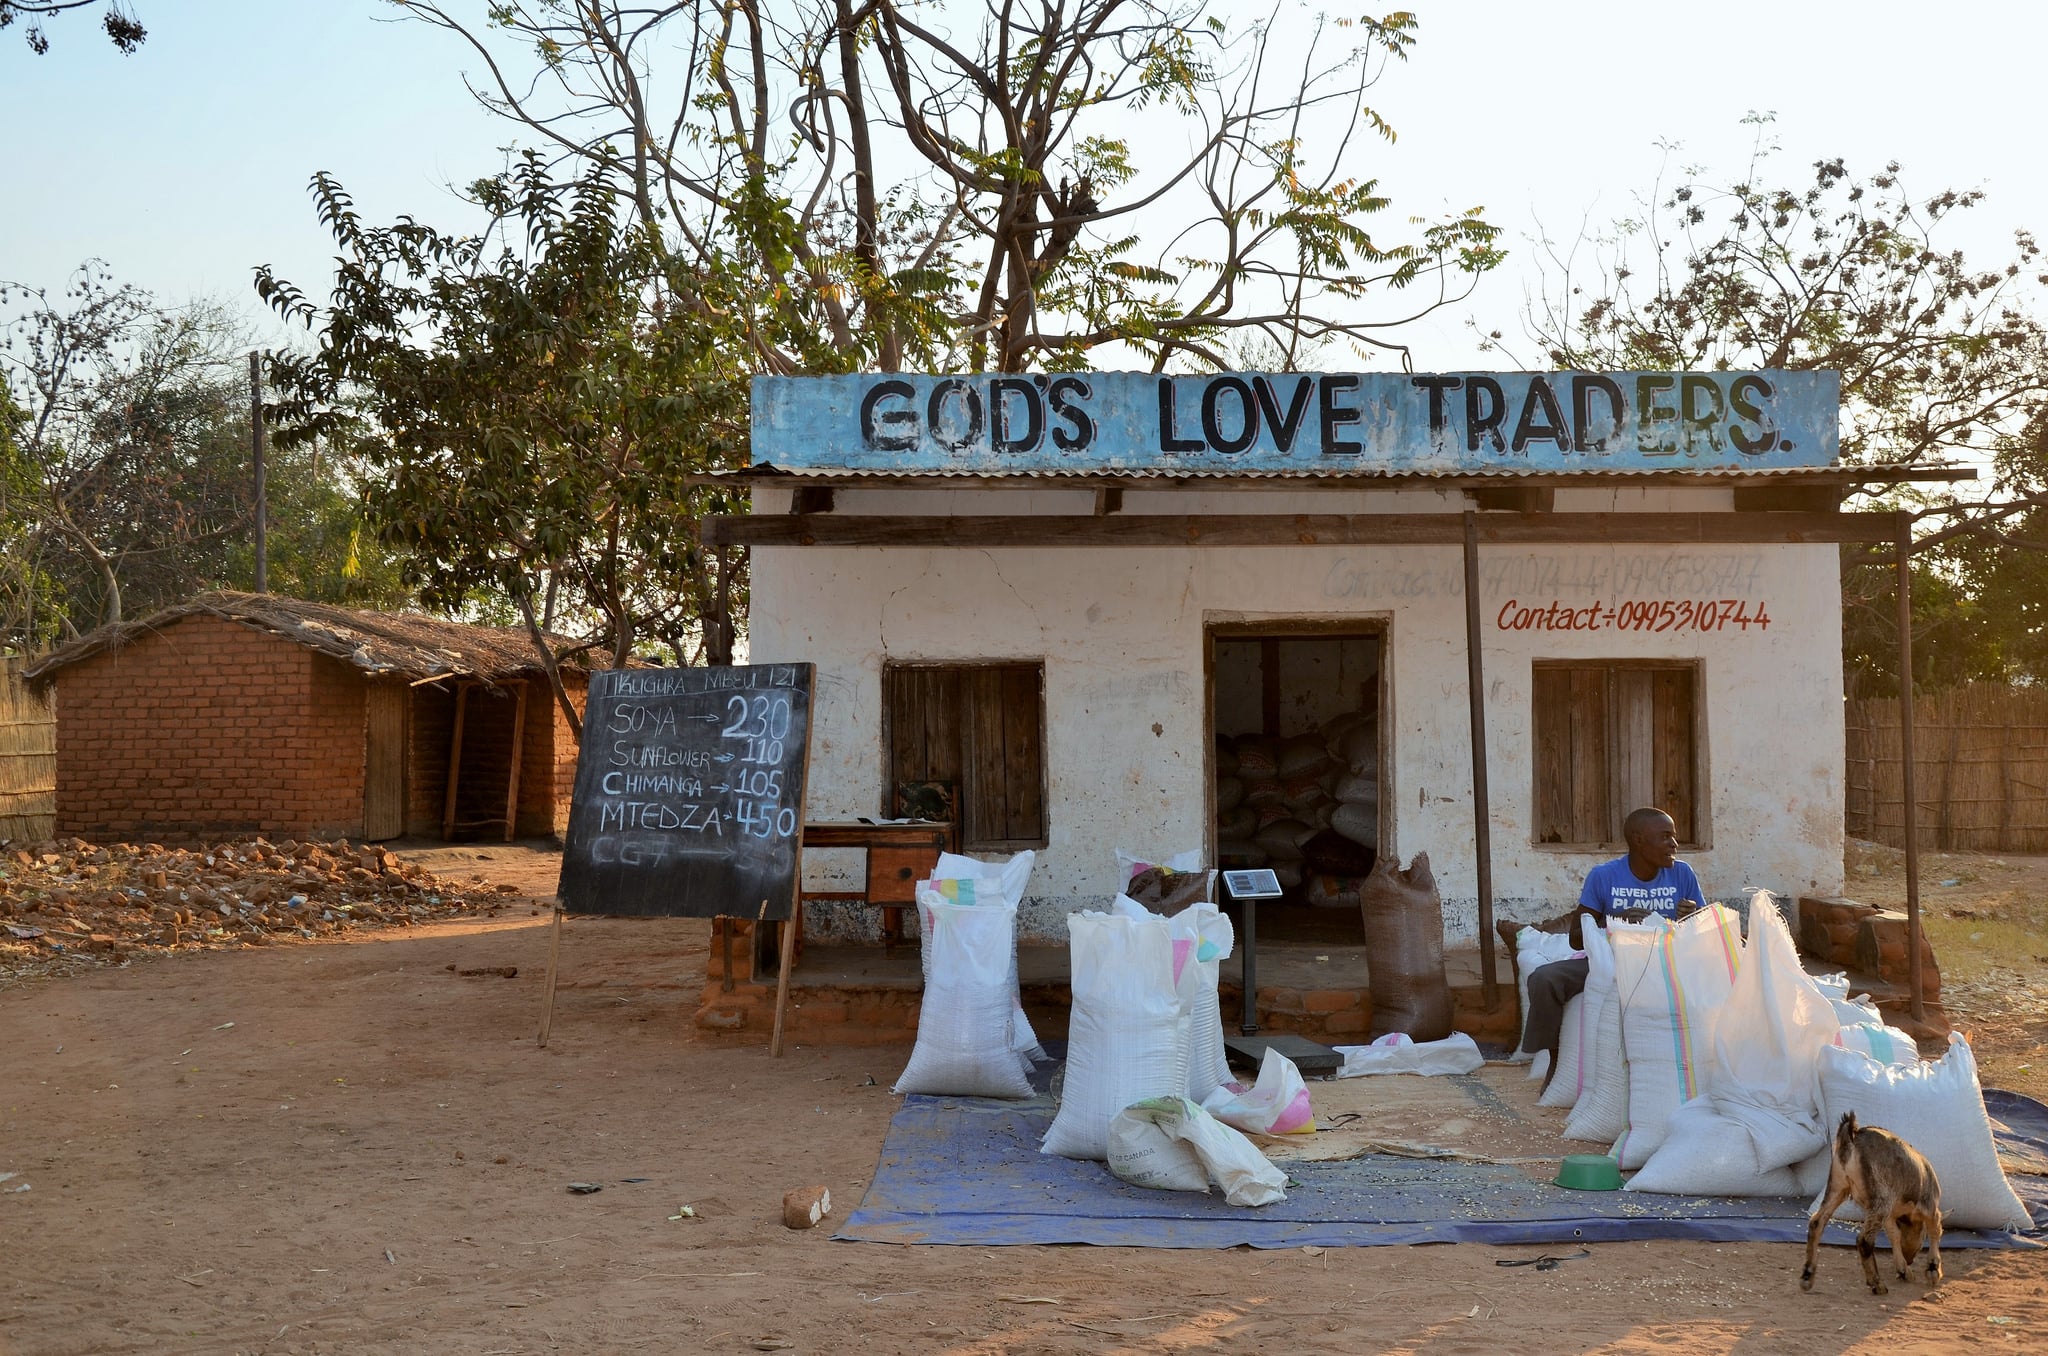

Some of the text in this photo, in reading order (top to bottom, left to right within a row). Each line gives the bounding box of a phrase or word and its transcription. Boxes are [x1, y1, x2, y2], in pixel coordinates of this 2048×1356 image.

[859, 376, 1096, 454] GOD'S
[1158, 376, 1366, 455] LOVE
[608, 694, 790, 740] SOYA 230
[609, 738, 784, 773] SUNFLOWER 110
[602, 767, 784, 799] CHIMANGA 105
[600, 798, 796, 838] MTEDZA 450
[1611, 886, 1677, 898] NEVER STOP
[1612, 898, 1675, 910] PLAYING
[1123, 1147, 1156, 1162] CANADA
